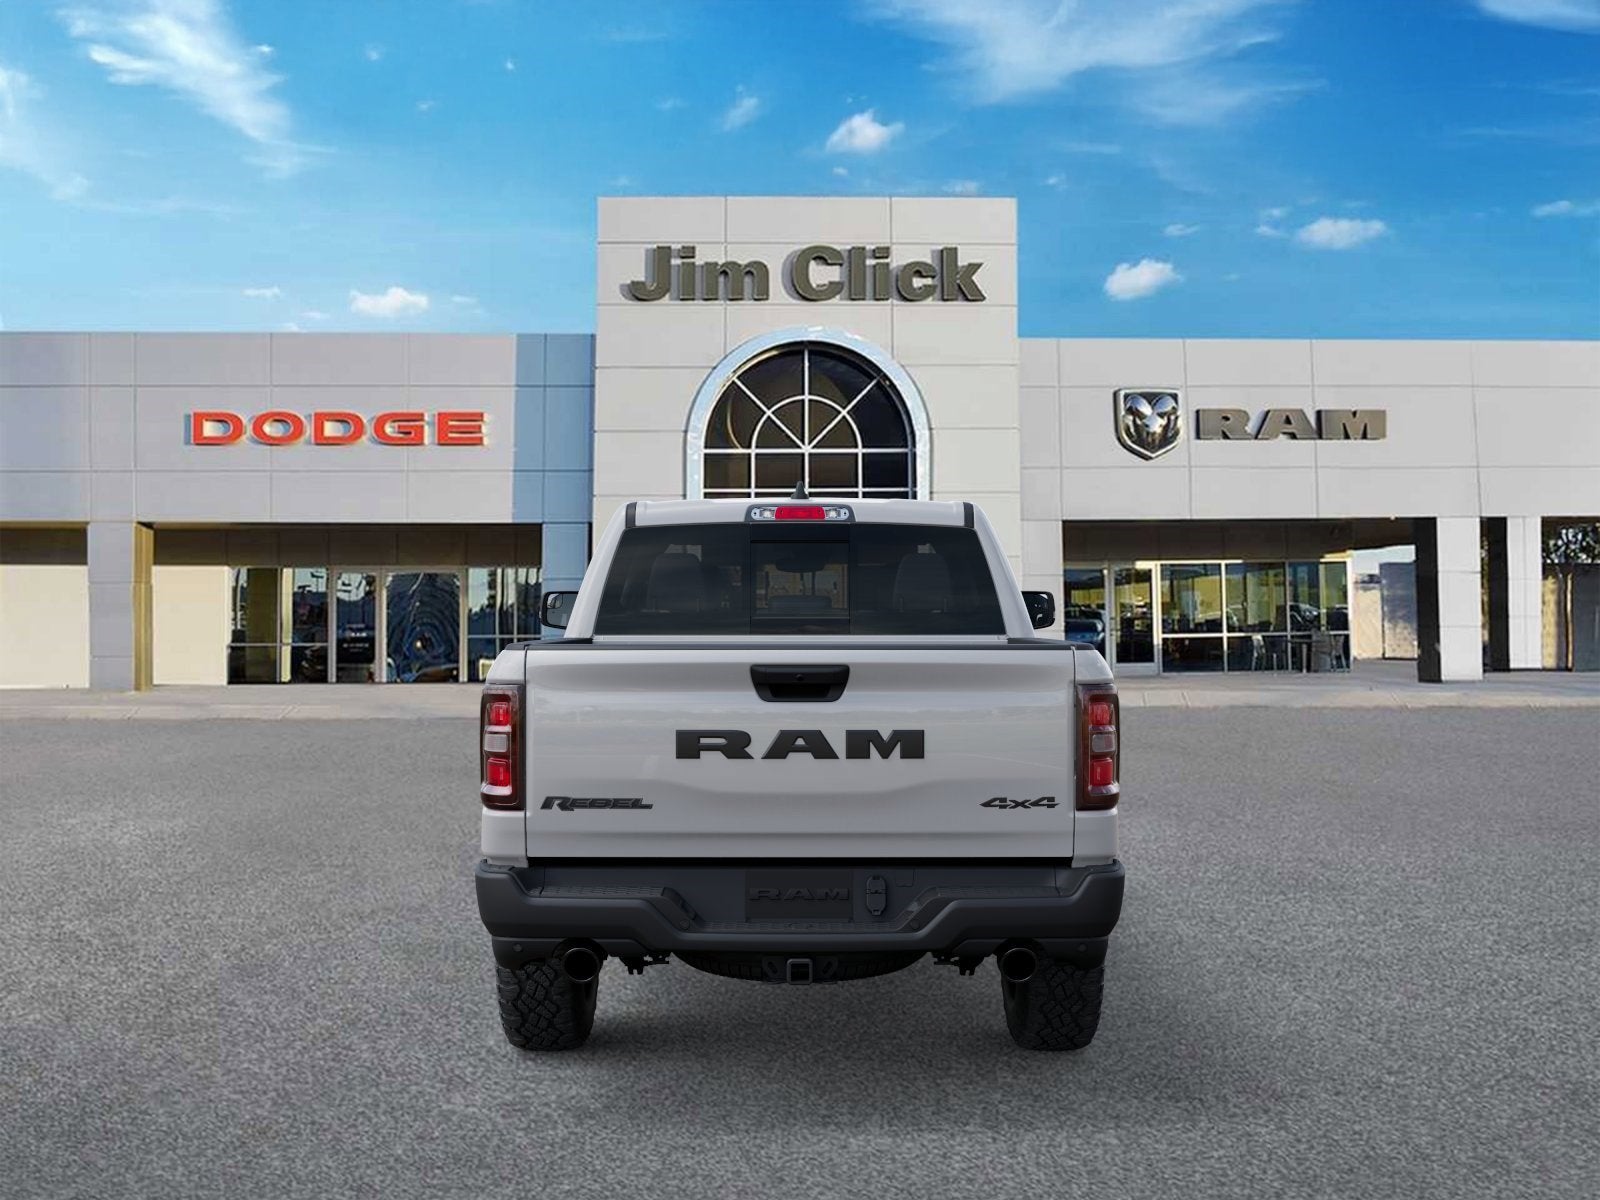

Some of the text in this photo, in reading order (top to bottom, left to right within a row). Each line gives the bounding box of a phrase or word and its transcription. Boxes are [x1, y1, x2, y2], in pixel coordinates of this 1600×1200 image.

[628, 244, 986, 303] Jim Click
[191, 410, 486, 446] DODGE
[1196, 408, 1387, 441] RAM
[675, 729, 925, 760] RAM
[980, 796, 1060, 809] 4x4
[750, 888, 849, 901] RAM
